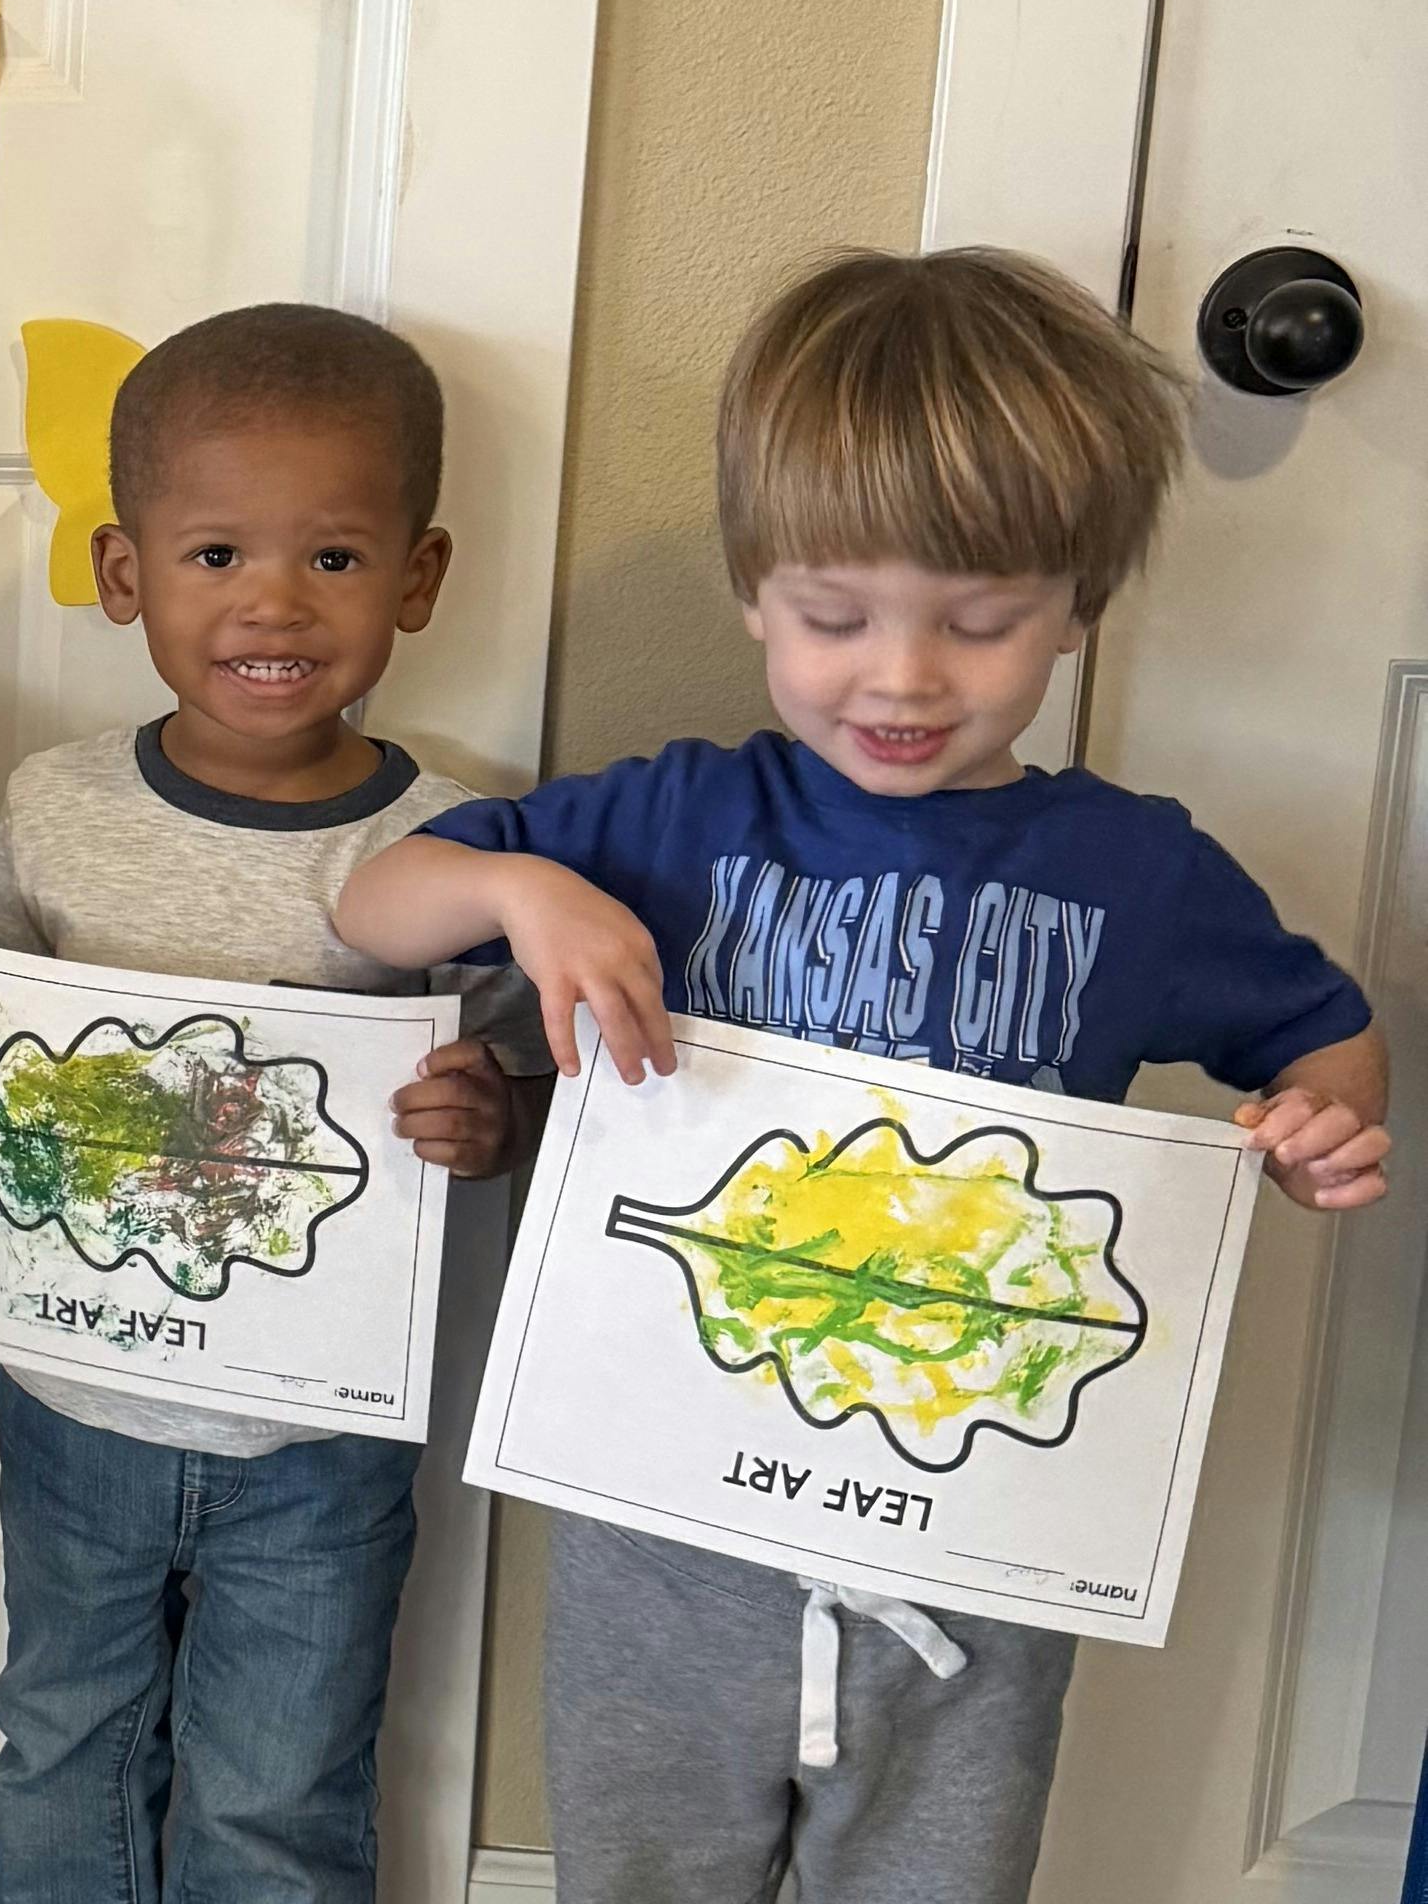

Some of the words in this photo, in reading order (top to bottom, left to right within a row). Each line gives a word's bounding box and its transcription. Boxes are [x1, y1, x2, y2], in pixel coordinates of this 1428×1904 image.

[685, 855, 945, 1041] KANSAS
[951, 881, 1106, 1065] CITY
[36, 1292, 108, 1331] ART
[119, 1312, 207, 1350] LEAF
[334, 1385, 395, 1407] name:
[723, 1450, 812, 1502] ART
[823, 1476, 934, 1532] LEAF
[1070, 1577, 1139, 1604] name:
